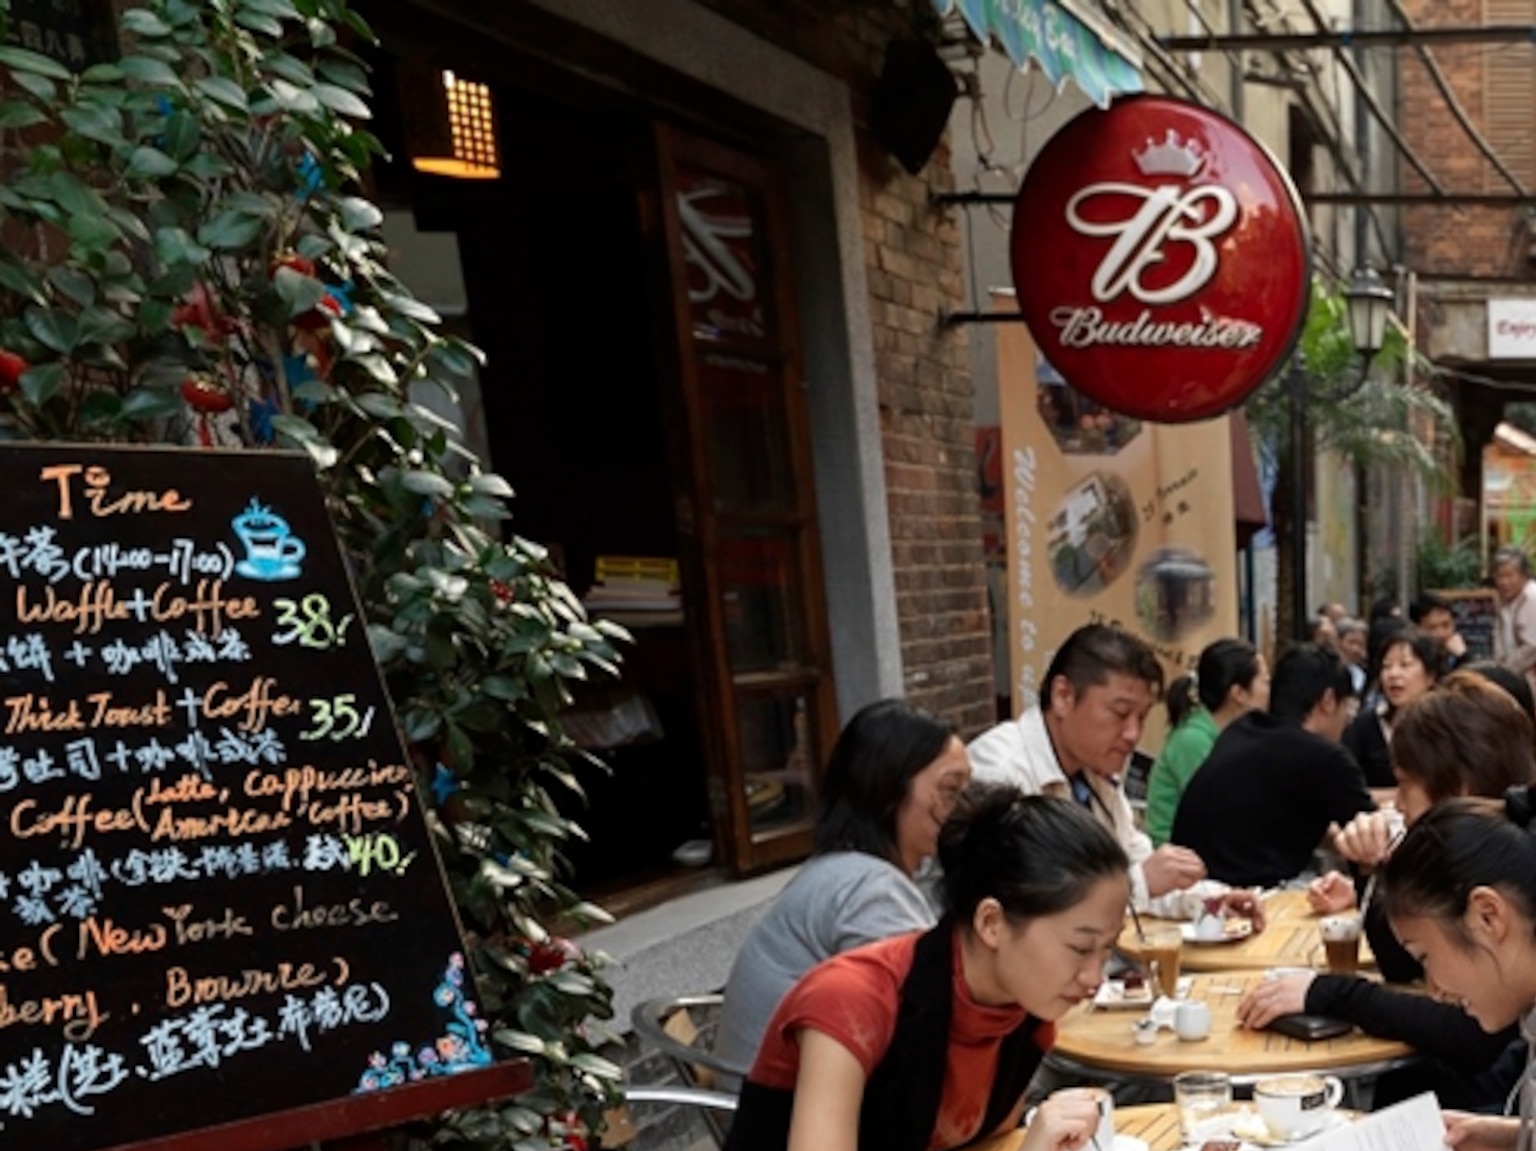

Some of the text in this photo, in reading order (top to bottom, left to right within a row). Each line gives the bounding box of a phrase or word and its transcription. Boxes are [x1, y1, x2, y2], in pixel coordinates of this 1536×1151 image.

[1050, 306, 1263, 347] Budweiser
[40, 463, 193, 520] Time
[1014, 446, 1037, 609] Welcome
[1019, 617, 1038, 651] to
[5, 692, 86, 734] Thick
[87, 690, 173, 727] Toast
